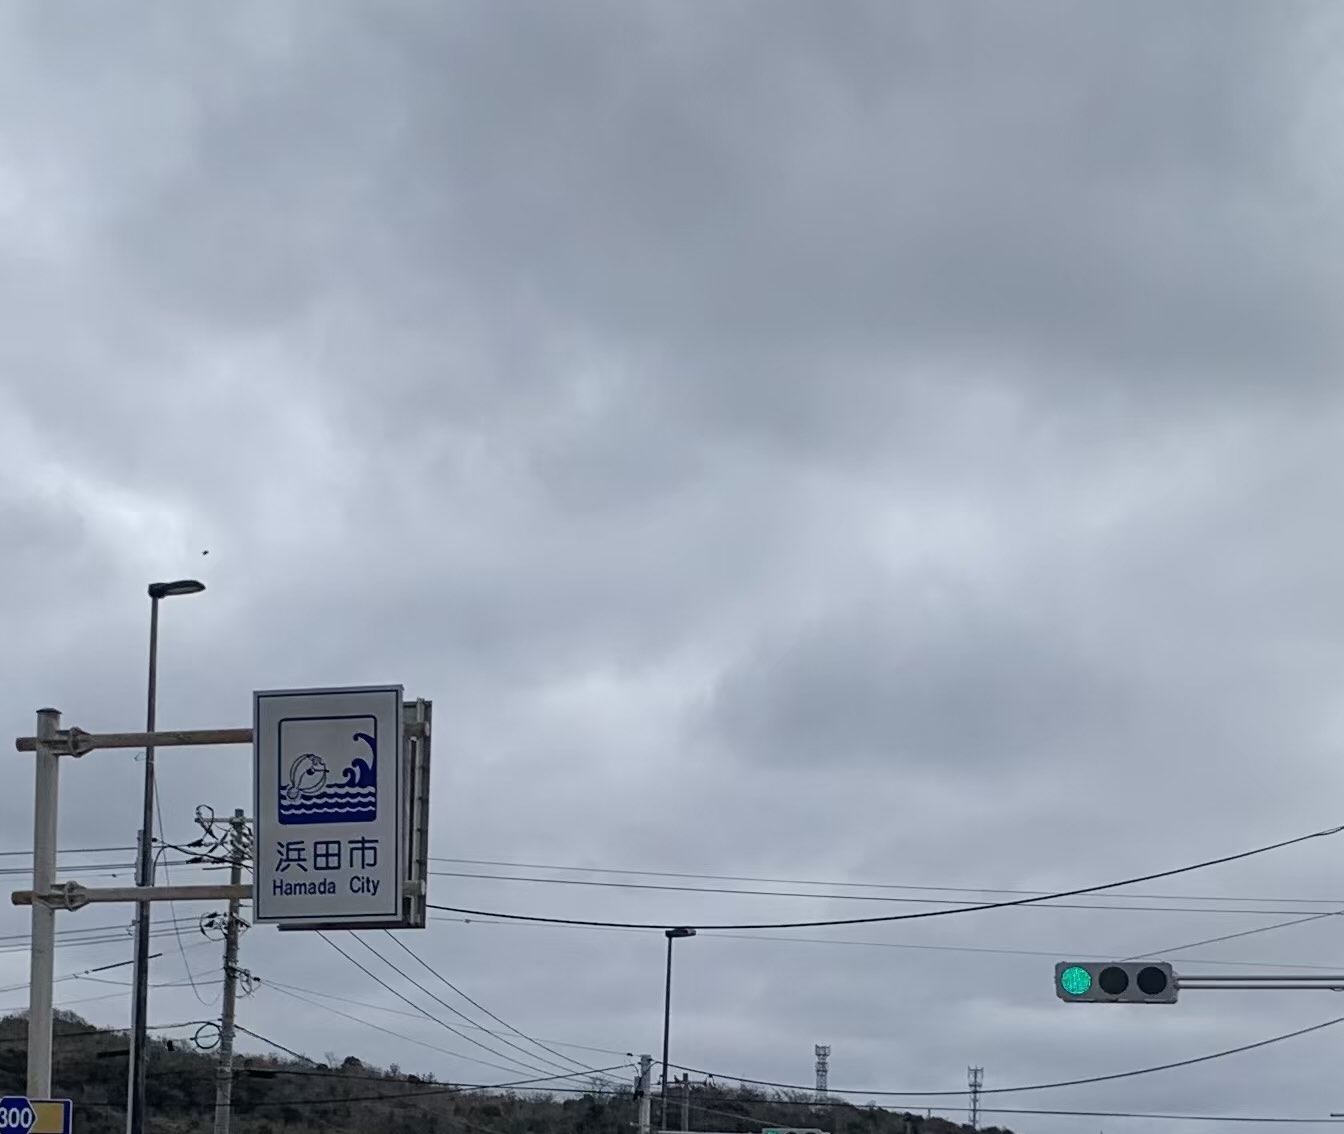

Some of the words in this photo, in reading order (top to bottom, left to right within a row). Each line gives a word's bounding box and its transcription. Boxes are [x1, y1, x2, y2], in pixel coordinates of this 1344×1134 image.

[275, 836, 379, 872] 浜田市
[272, 878, 336, 896] Hamada
[349, 875, 380, 896] City
